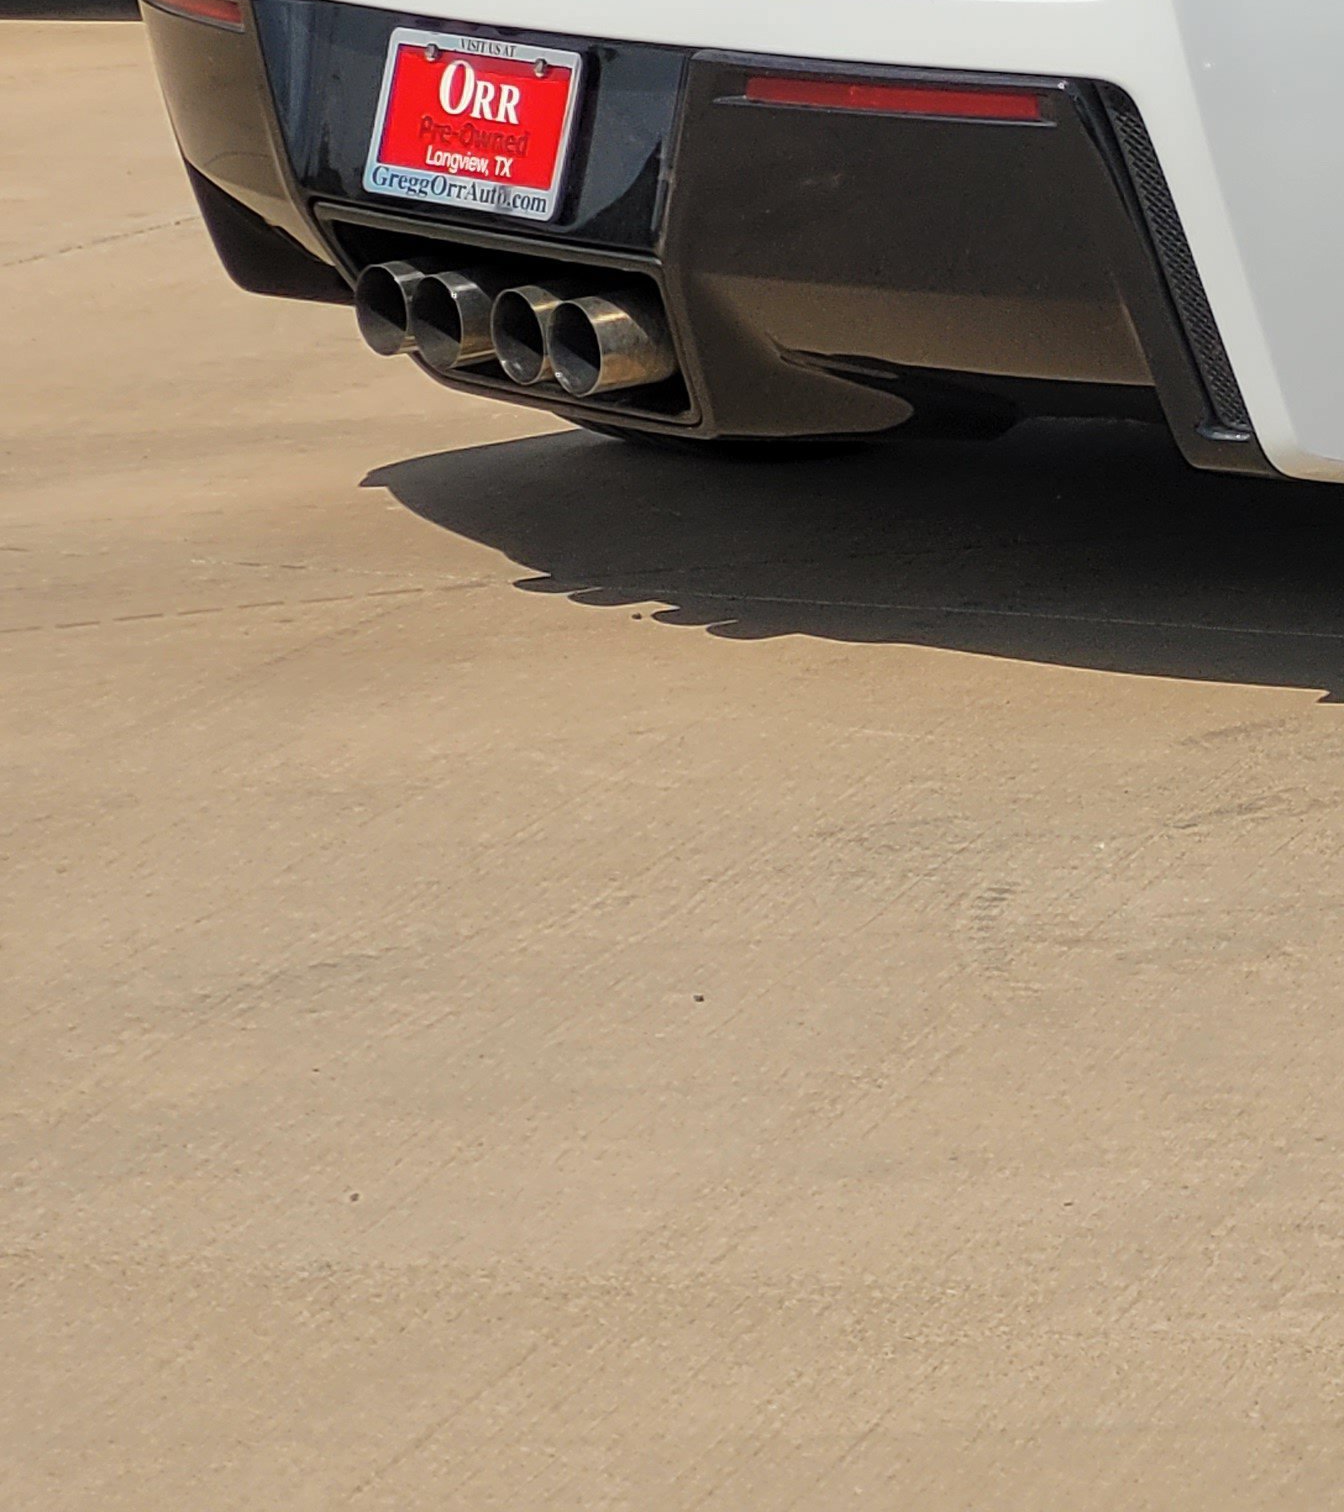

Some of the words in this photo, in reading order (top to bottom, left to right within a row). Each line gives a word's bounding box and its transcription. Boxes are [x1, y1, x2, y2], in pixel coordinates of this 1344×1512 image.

[459, 38, 486, 54] VISIT
[487, 42, 501, 56] US
[502, 45, 517, 58] AT
[419, 115, 530, 158] Pre-Owned
[425, 144, 489, 177] Longview,
[494, 154, 513, 178] TX
[371, 166, 546, 213] GreggOrrAuto.com
